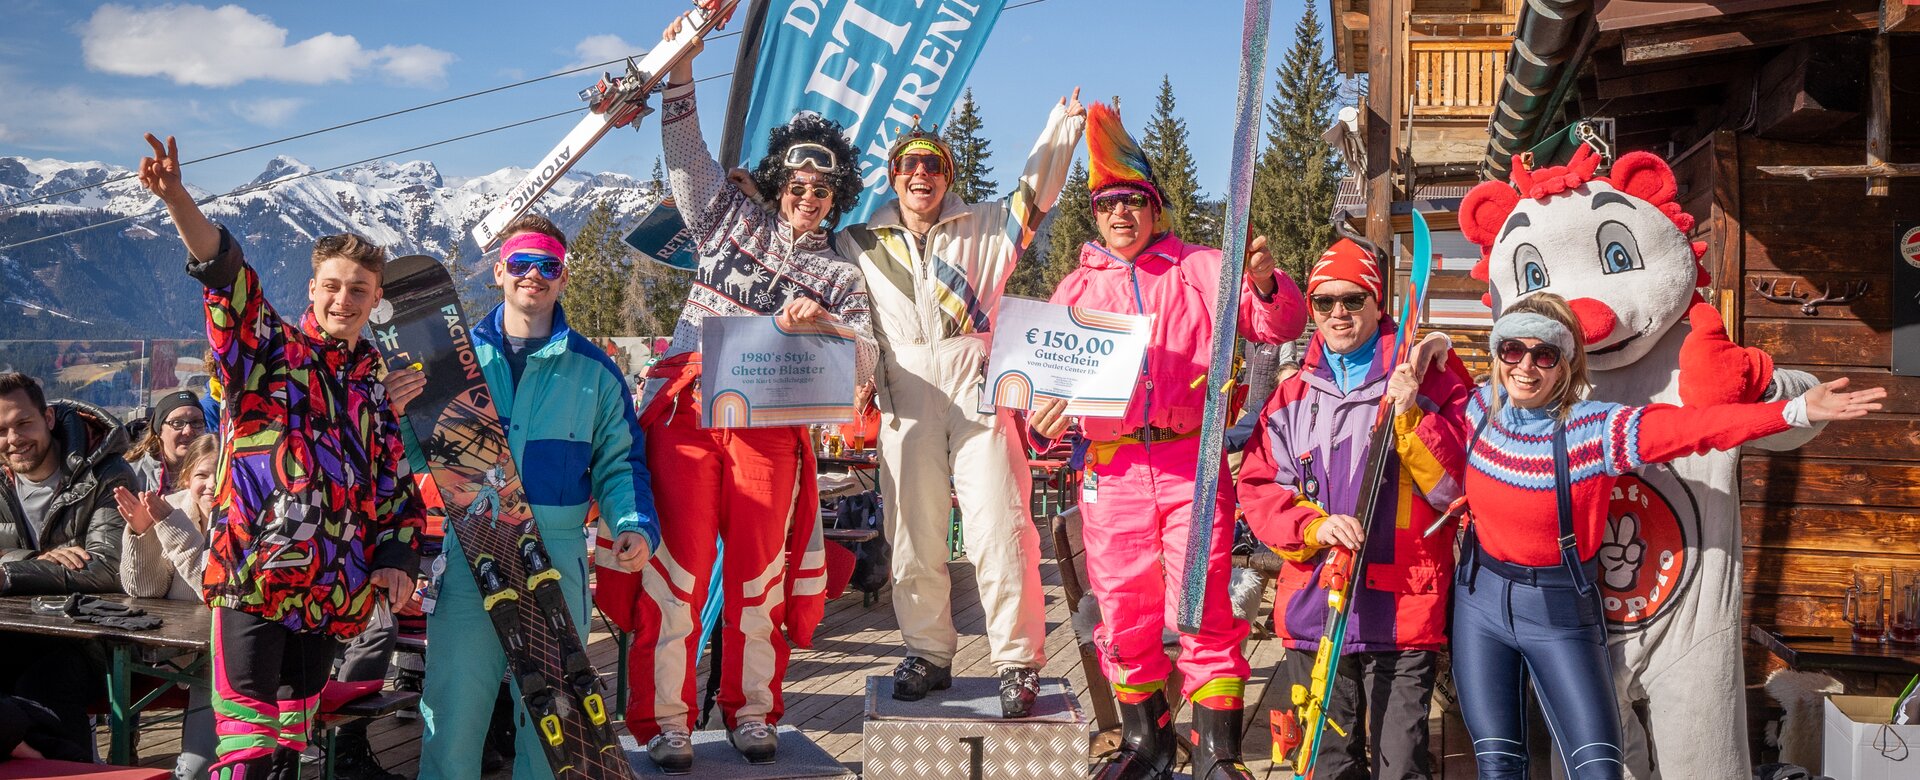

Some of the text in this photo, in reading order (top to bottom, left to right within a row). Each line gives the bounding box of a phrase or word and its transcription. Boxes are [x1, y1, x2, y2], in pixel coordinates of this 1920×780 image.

[510, 145, 572, 213] ATOMIC
[480, 221, 494, 241] 185
[656, 227, 692, 260] RETR
[440, 303, 481, 381] FACTION
[1042, 329, 1114, 356] 150,00
[731, 364, 825, 376] Ghetto Blaster
[784, 351, 816, 364] Style
[1034, 348, 1099, 368] Gutschein
[1042, 361, 1064, 371] Outlet
[1064, 364, 1087, 374] Center
[1609, 484, 1649, 509] nte
[1603, 550, 1675, 618] opolo
[1434, 680, 1455, 704] HEAD
[959, 736, 984, 780] 1
